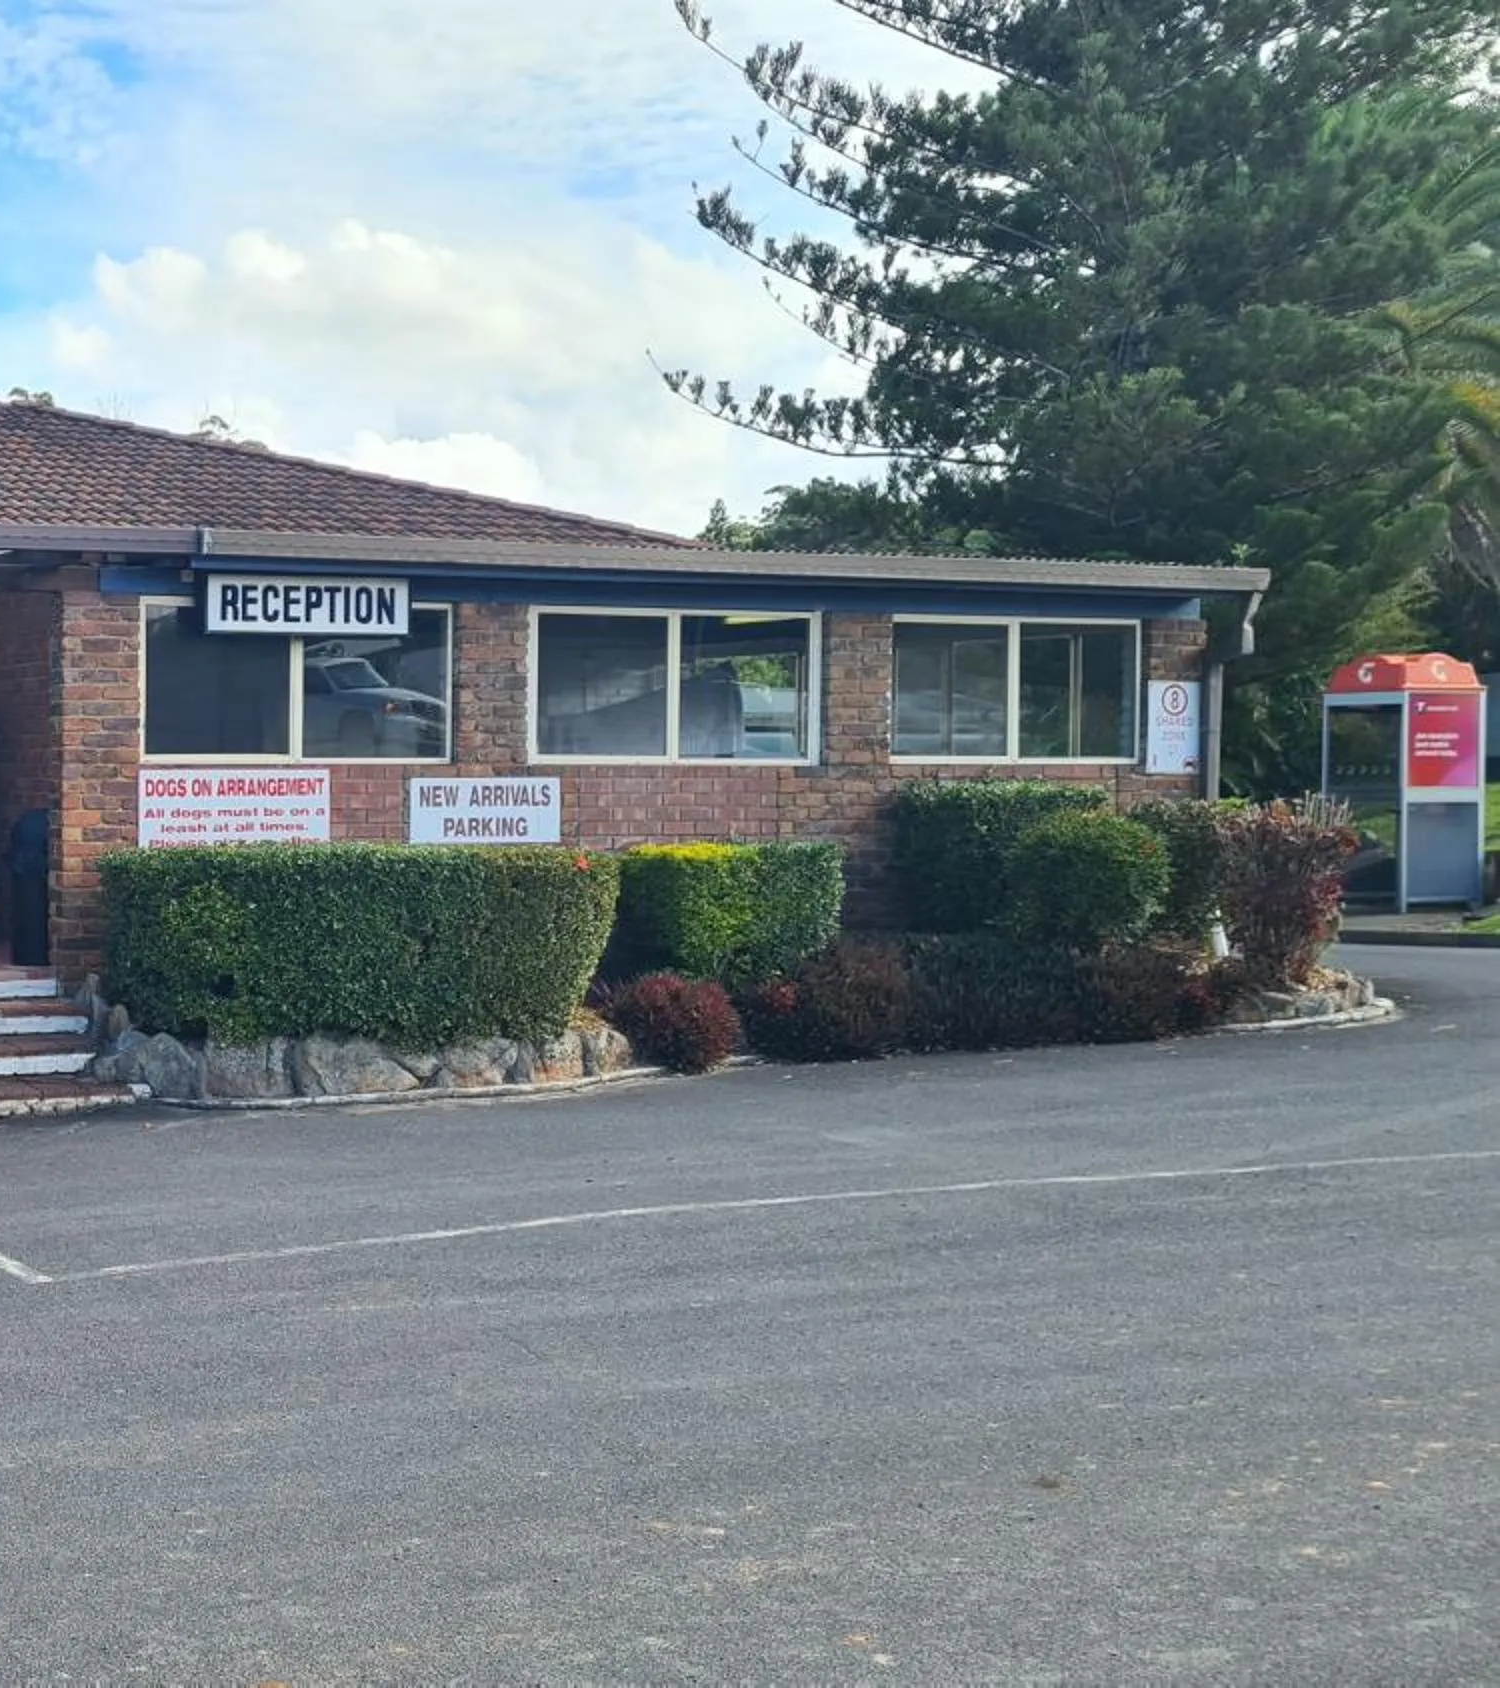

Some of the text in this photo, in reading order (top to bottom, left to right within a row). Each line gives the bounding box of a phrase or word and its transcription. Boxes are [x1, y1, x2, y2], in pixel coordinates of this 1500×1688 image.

[220, 584, 395, 625] RECEPTION
[1171, 690, 1179, 710] 8
[145, 778, 325, 797] DOGS ON ARRANGEMENT
[419, 784, 551, 807] NEW ARRIVALS
[144, 807, 325, 820] All dogs must be on a
[161, 822, 308, 833] leash at all times.
[443, 817, 528, 837] PARKING
